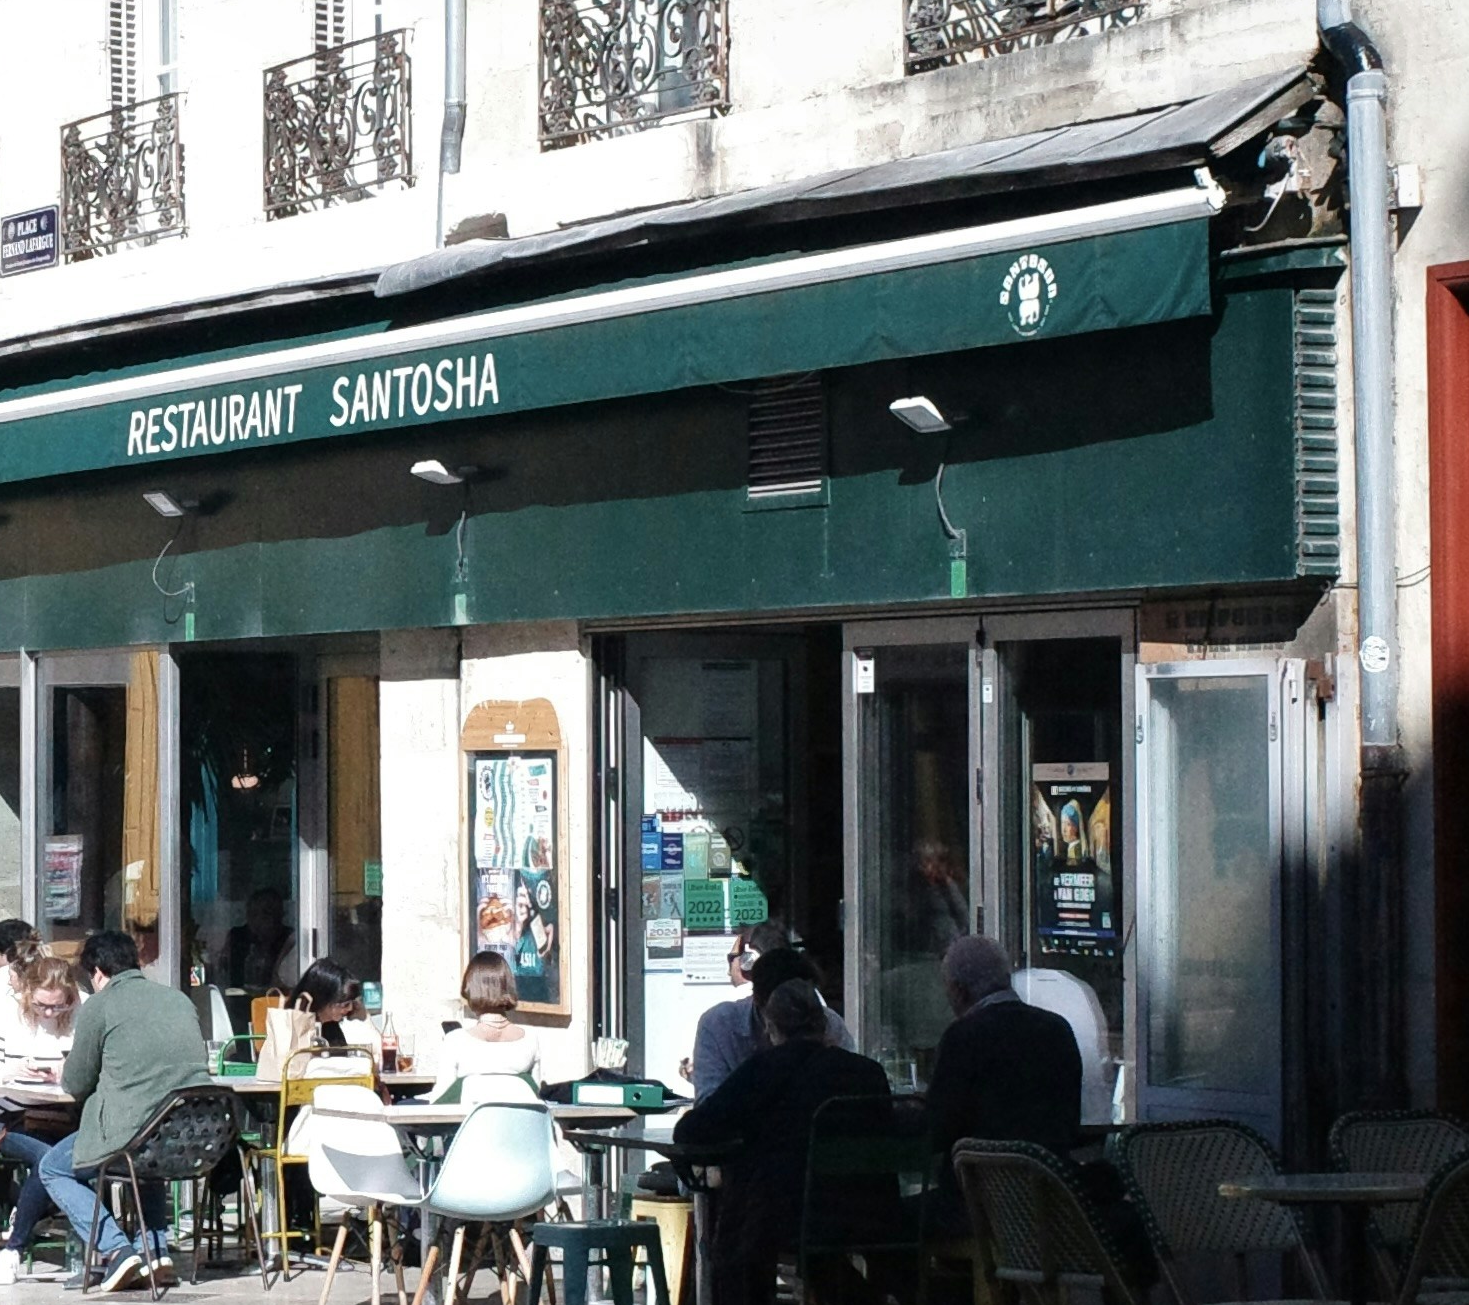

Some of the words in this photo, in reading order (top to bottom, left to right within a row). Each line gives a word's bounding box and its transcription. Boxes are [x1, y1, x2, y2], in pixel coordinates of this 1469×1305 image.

[17, 218, 37, 236] PLACE
[127, 384, 303, 456] RESTAURANT
[329, 353, 500, 428] SANTOSHA
[688, 901, 721, 914] 2022
[734, 909, 764, 921] 2023
